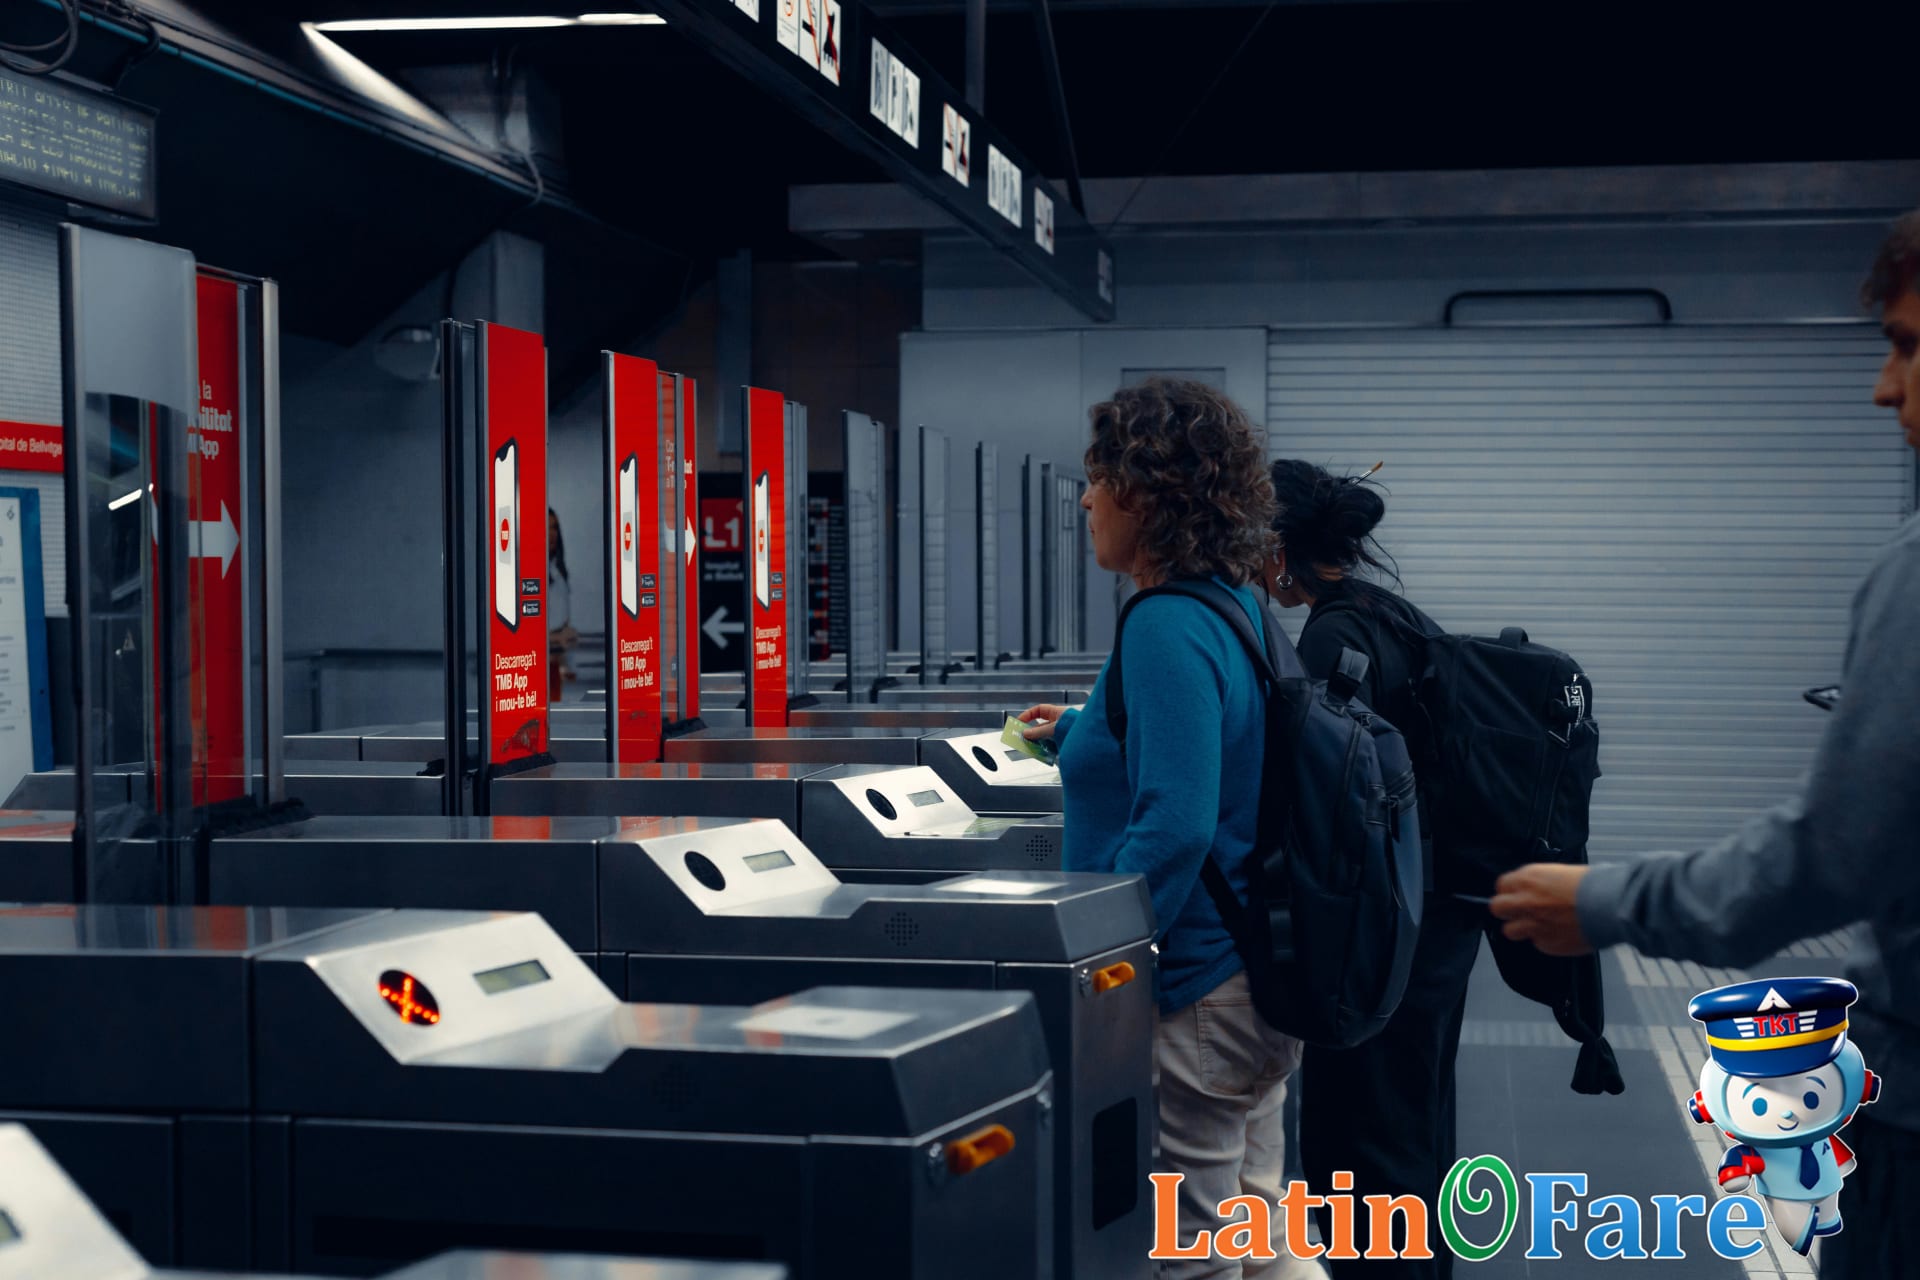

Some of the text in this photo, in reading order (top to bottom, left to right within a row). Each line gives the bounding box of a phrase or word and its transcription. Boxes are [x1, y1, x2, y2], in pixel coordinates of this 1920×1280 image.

[202, 378, 212, 400] la
[16, 437, 28, 453] de
[703, 514, 741, 548] L1
[620, 636, 653, 655] Descarrega't
[495, 650, 537, 671] Descarrega't
[620, 656, 647, 672] TMB App
[495, 673, 528, 692] TMB App
[624, 674, 644, 690] mou-te
[495, 690, 537, 713] i mou-te bé!
